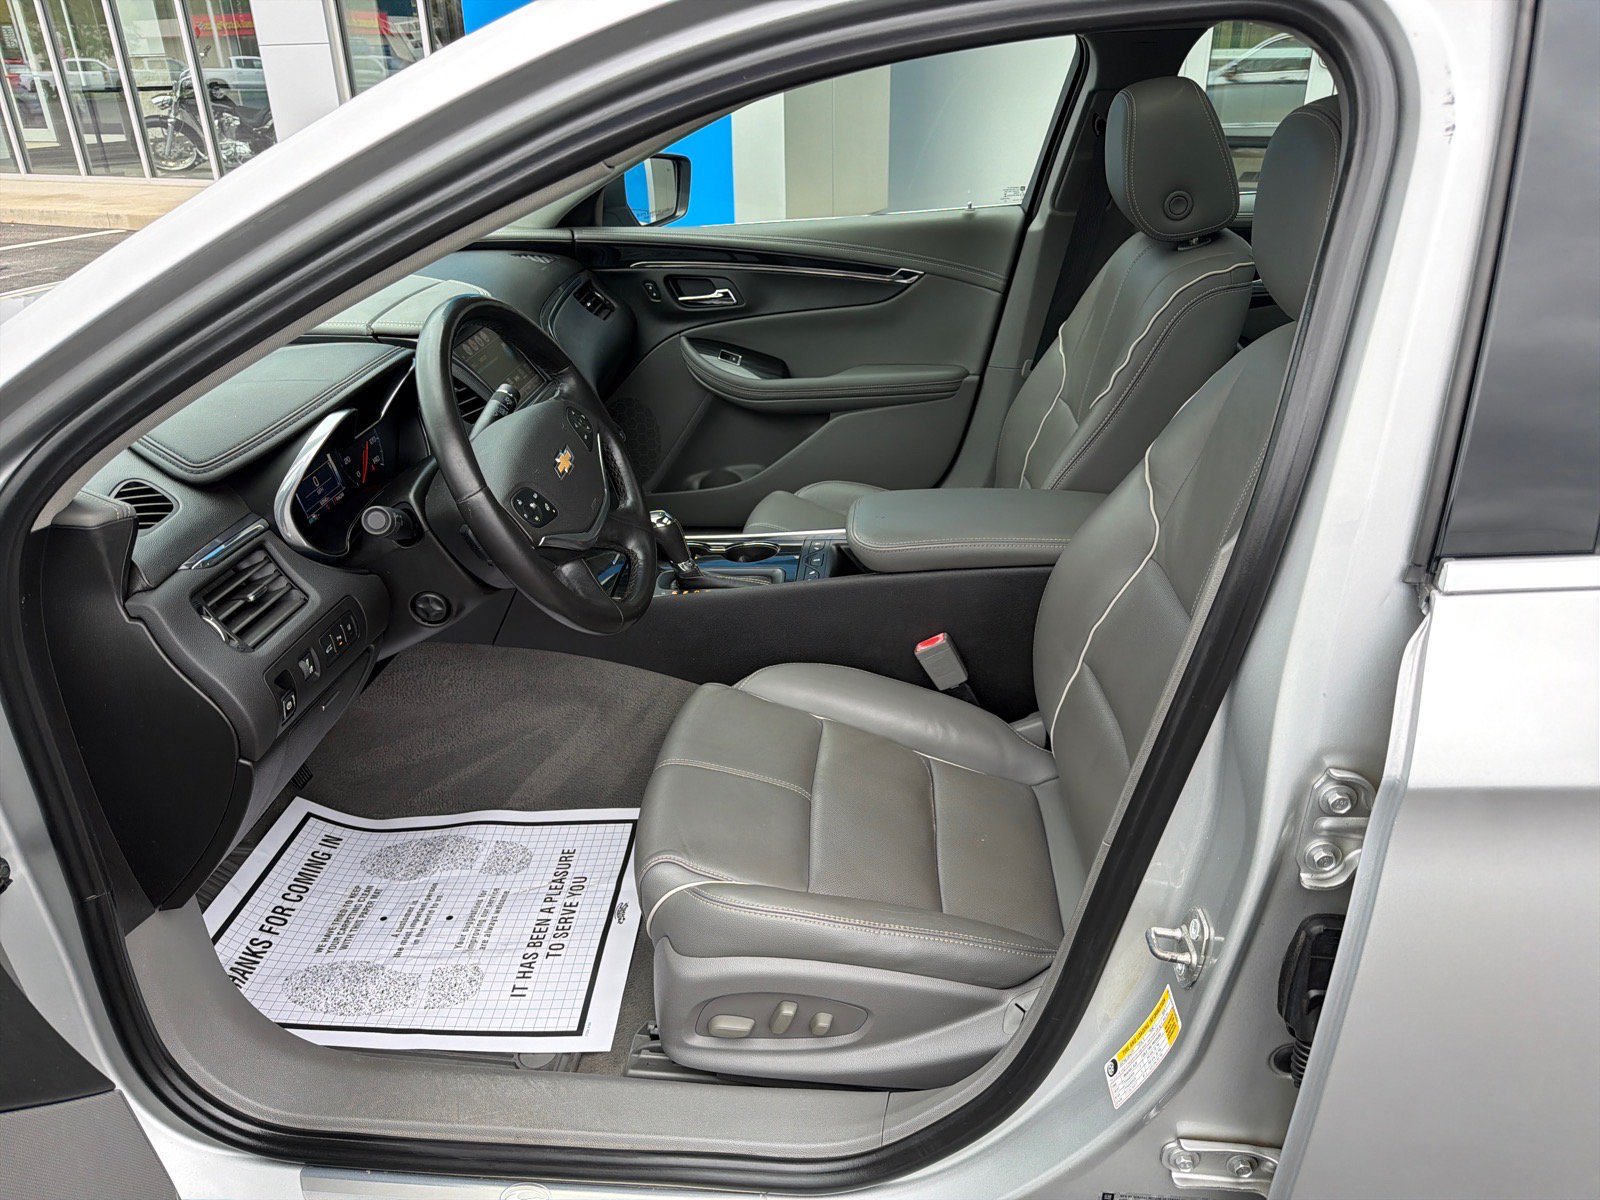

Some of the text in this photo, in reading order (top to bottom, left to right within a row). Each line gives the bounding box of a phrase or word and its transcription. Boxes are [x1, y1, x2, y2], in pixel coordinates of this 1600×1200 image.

[228, 834, 344, 989] HANKS FOR COMING IN
[314, 884, 362, 953] WE HAVE TRIED TO KEEP
[325, 884, 374, 954] YOUR CARPETING CLEAN
[339, 888, 383, 951] WITH THIS PAPER MAT
[392, 883, 439, 958] the most important person
[395, 906, 415, 933] customer
[415, 927, 427, 938] the
[422, 910, 435, 927] world
[454, 889, 488, 949] Your suggestions for
[466, 887, 500, 951] improving our service
[483, 915, 498, 938] always
[510, 848, 577, 997] IT HAS BEEN A PLEASURE
[545, 876, 588, 959] TO SERVE YOU
[479, 939, 489, 951] are
